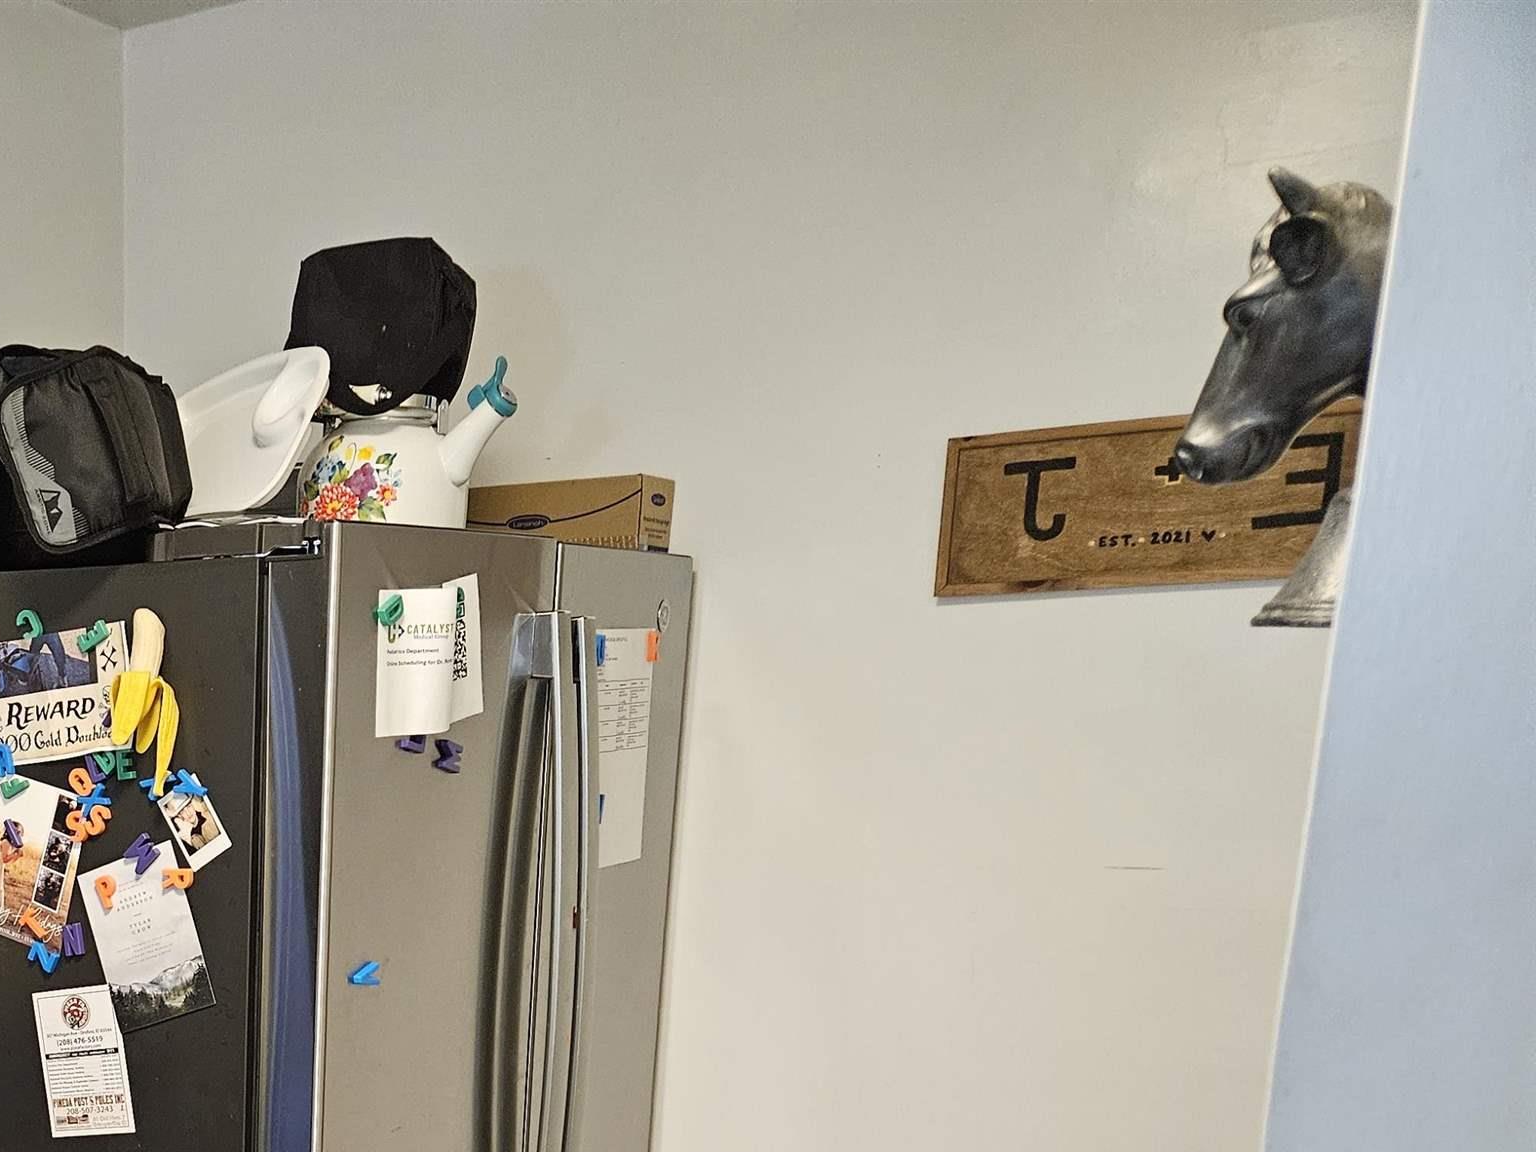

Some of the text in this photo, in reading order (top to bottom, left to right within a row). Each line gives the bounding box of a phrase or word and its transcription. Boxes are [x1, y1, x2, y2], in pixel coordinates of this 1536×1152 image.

[1099, 530, 1191, 548] EST. 2021
[407, 623, 454, 635] CATALYST
[34, 729, 62, 751] Gold
[95, 875, 117, 910] P
[11, 904, 64, 943] Hlidays
[67, 1105, 114, 1115] 208-507-3243
